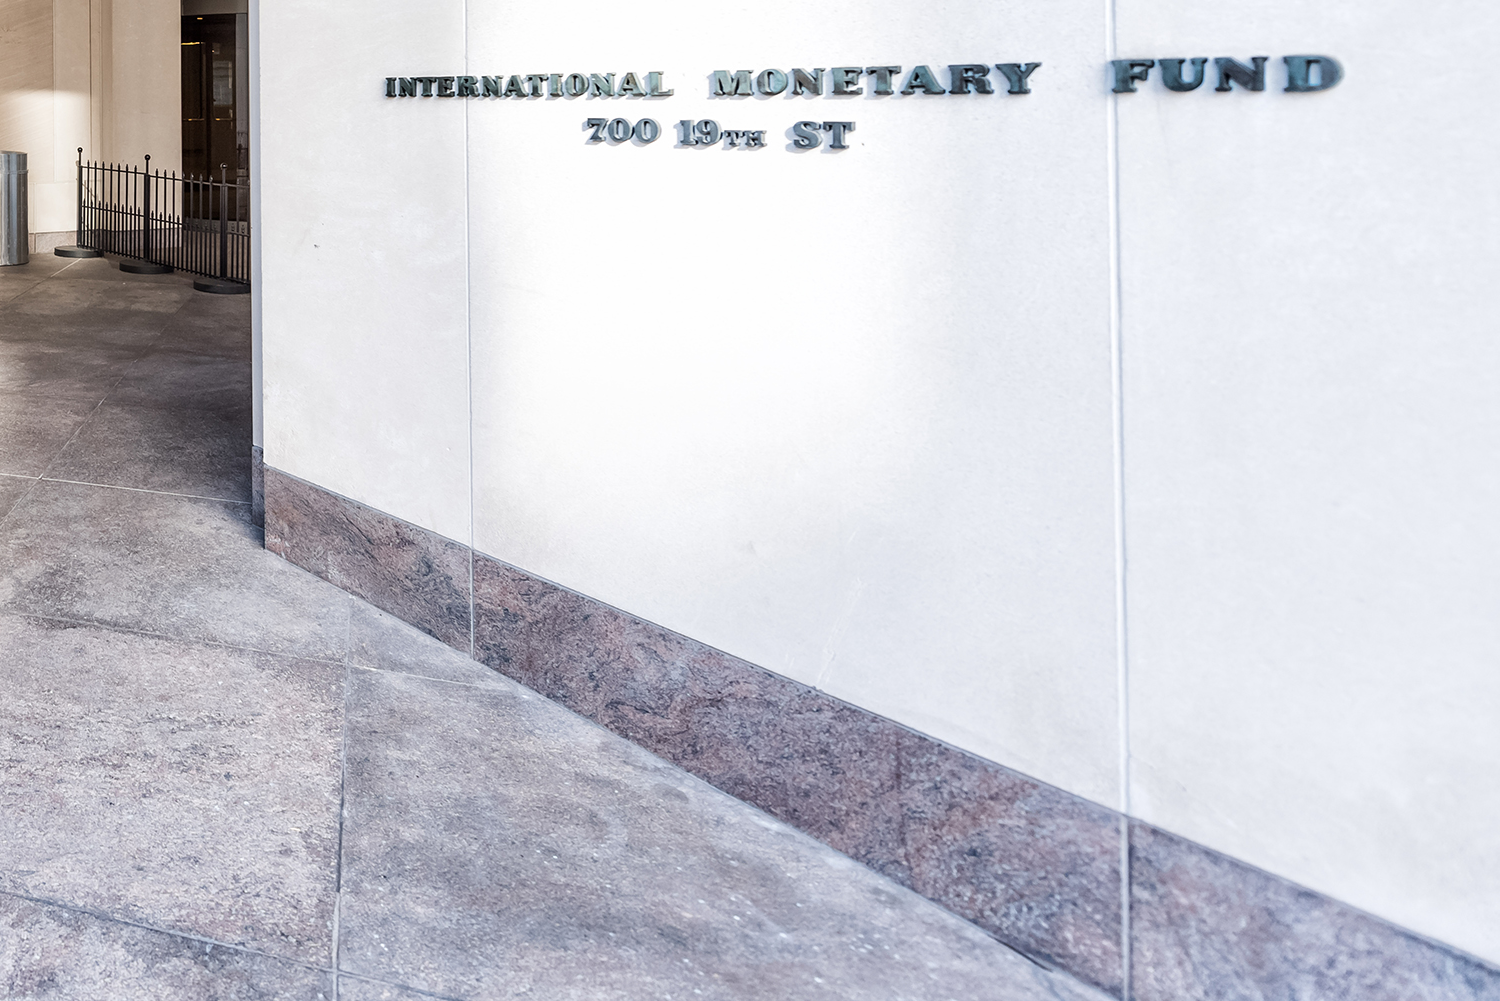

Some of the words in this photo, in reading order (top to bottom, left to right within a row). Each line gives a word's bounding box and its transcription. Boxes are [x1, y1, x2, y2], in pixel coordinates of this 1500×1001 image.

[384, 71, 674, 98] INTERNATIONAL
[713, 62, 1042, 97] MONETARY
[1111, 55, 1344, 93] FUND
[586, 117, 662, 144] 700
[678, 119, 767, 148] 19TH
[791, 121, 856, 150] ST
